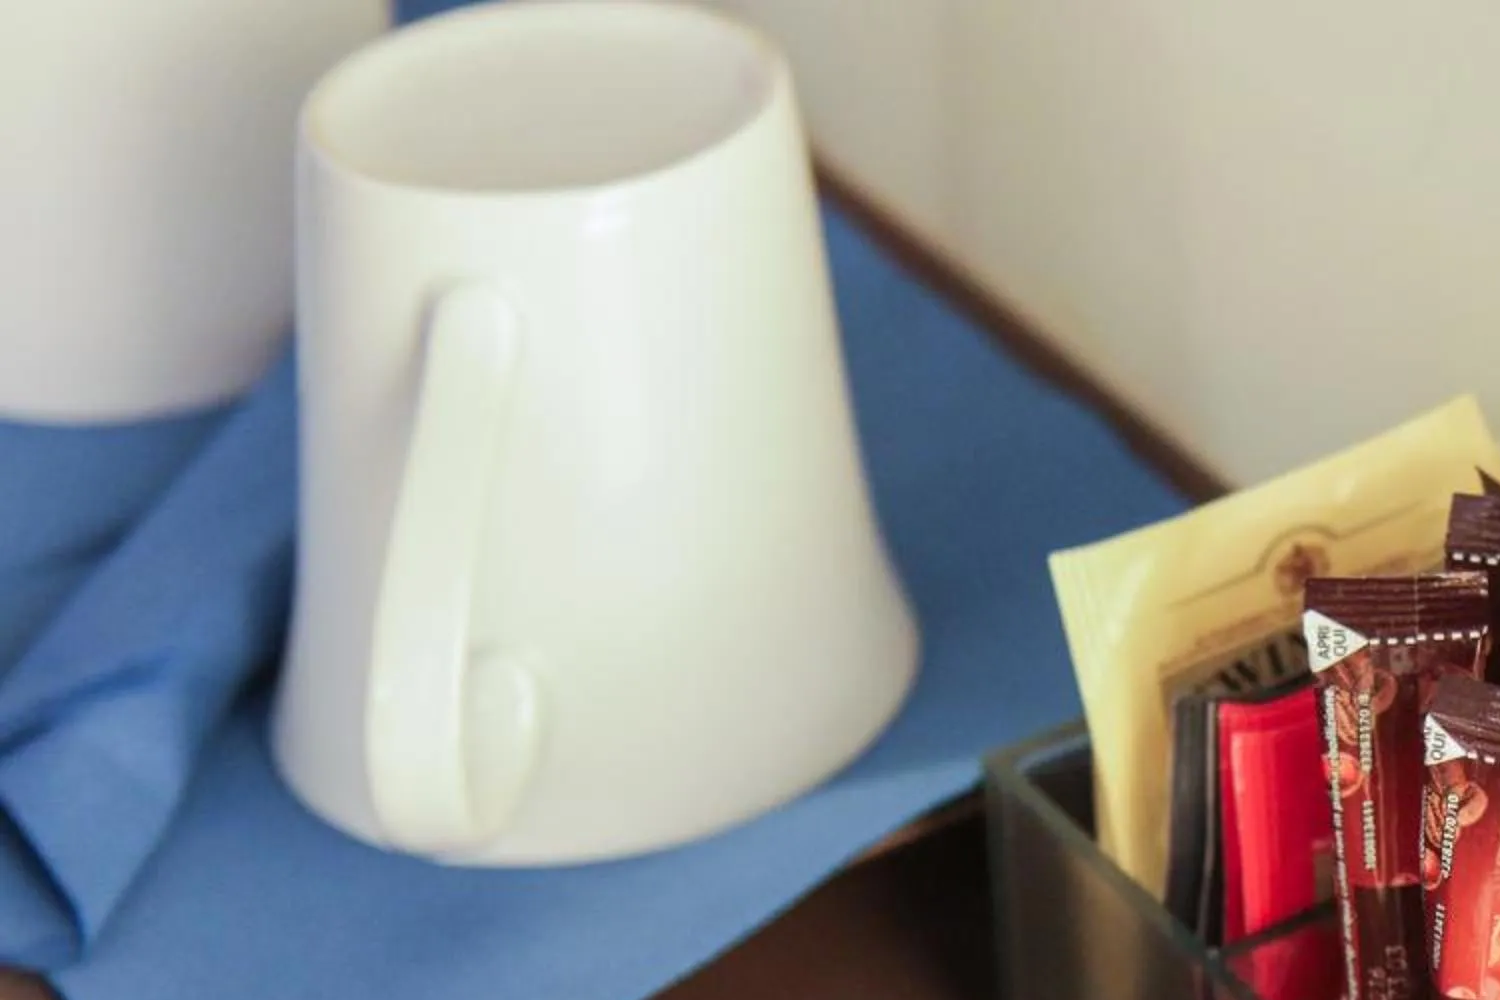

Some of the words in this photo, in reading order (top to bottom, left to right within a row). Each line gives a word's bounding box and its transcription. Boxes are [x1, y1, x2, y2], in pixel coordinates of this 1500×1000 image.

[1316, 624, 1330, 660] APRI
[1332, 627, 1347, 657] QUI
[1430, 731, 1447, 761] QUI
